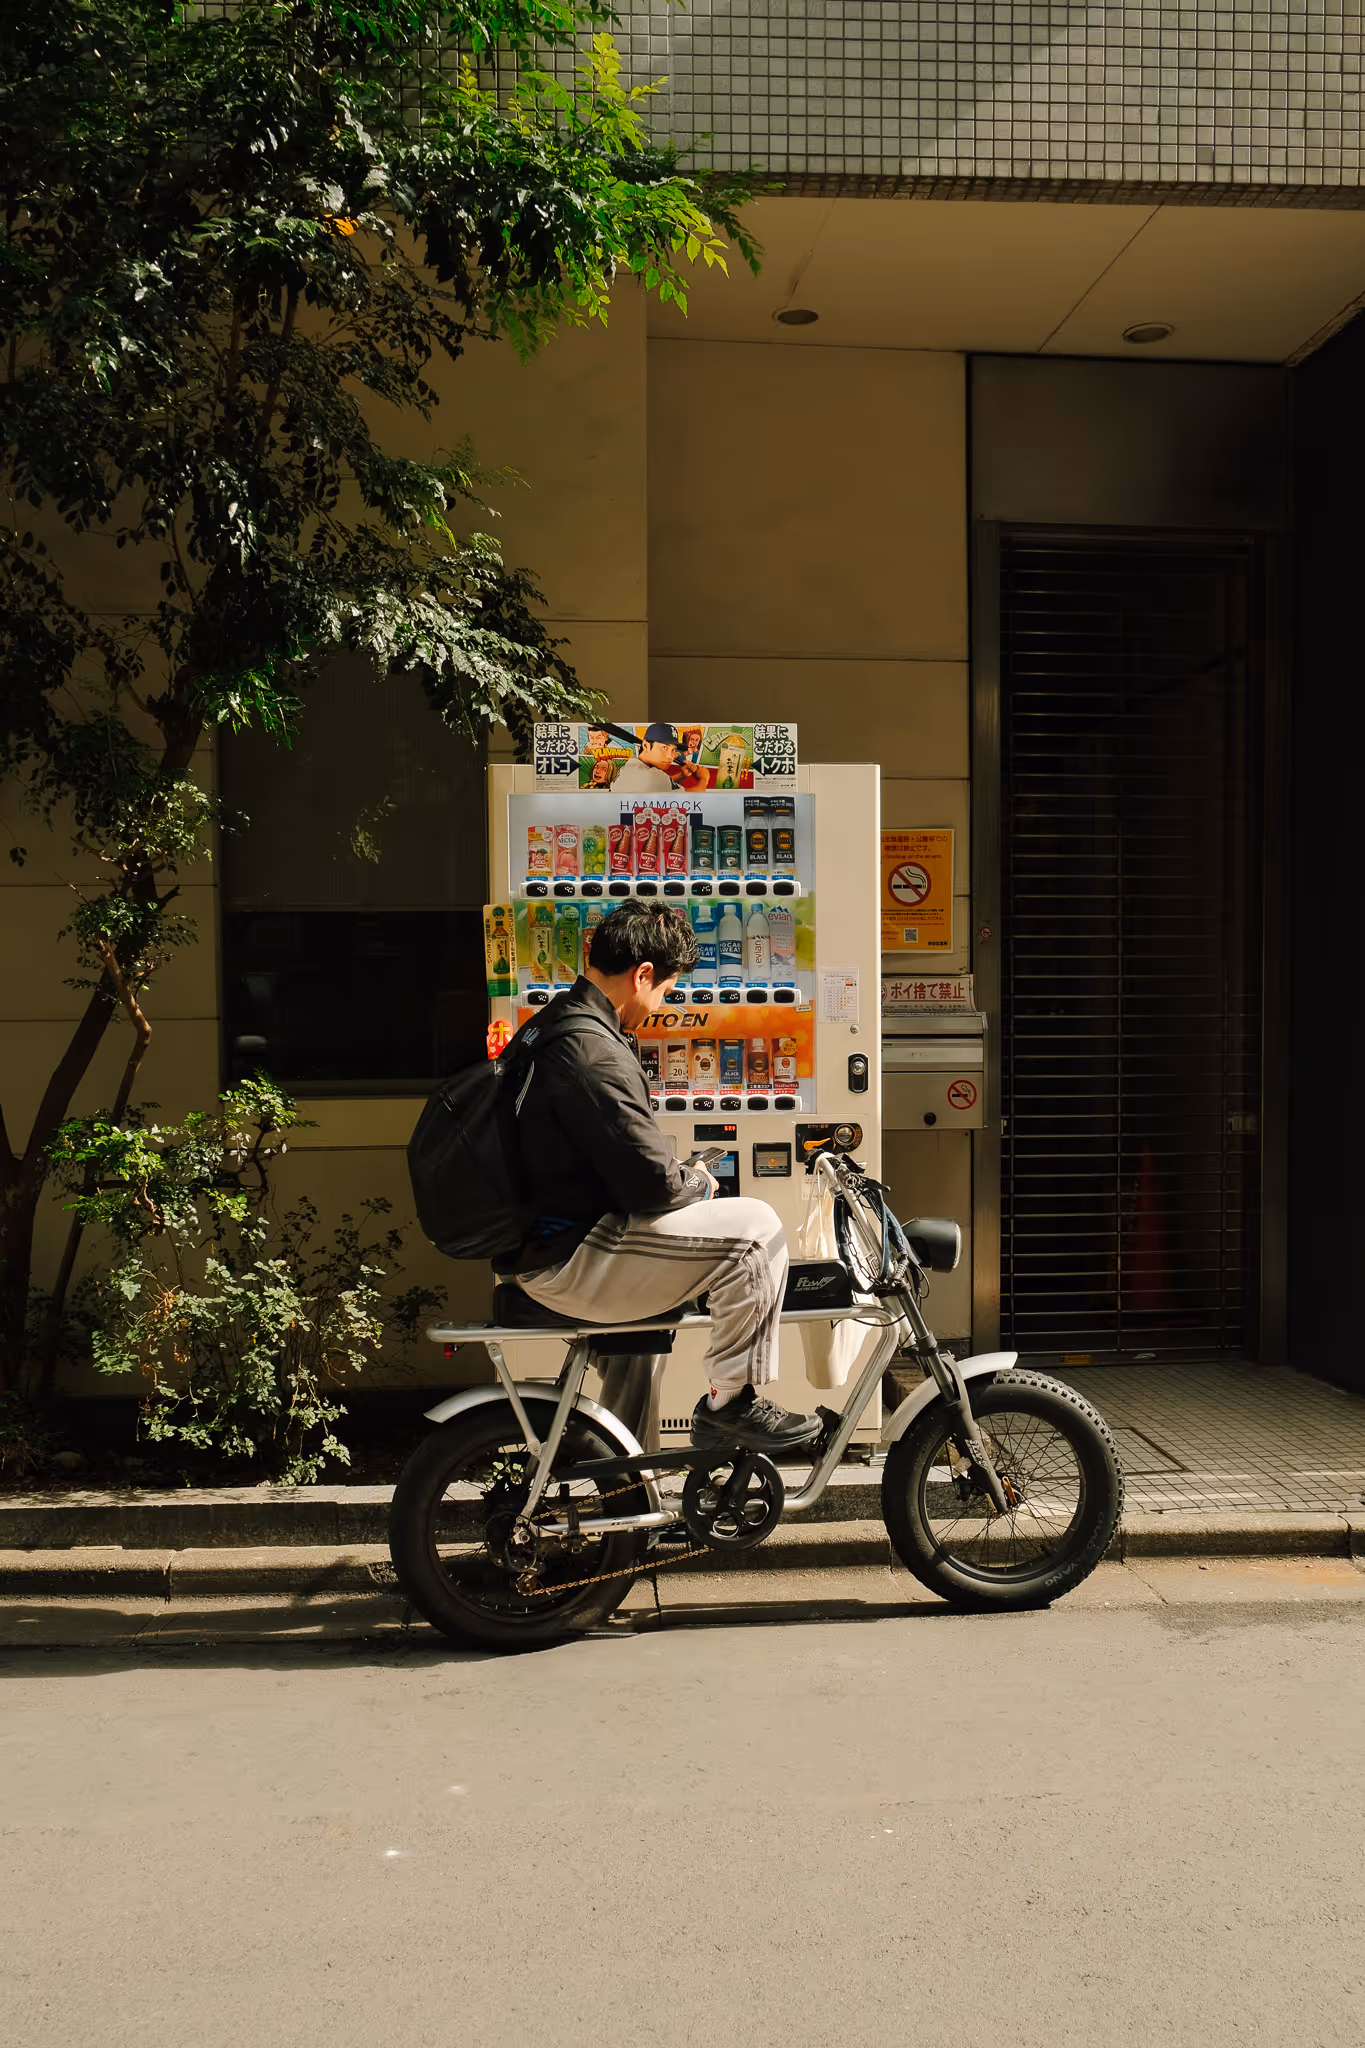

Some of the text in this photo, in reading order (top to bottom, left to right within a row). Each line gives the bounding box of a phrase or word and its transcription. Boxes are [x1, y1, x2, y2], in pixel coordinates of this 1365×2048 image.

[536, 724, 569, 739] 結果に
[755, 724, 787, 739] 結果に
[536, 740, 577, 754] こだわる
[755, 740, 794, 754] こだわる
[537, 757, 571, 774] オトコ
[760, 757, 794, 774] トクホ
[620, 800, 702, 812] HAMMOCK
[768, 912, 792, 921] evian
[890, 981, 966, 1000] ポイ捨て禁止
[642, 1013, 709, 1028] ITO EN
[673, 1068, 683, 1077] 20
